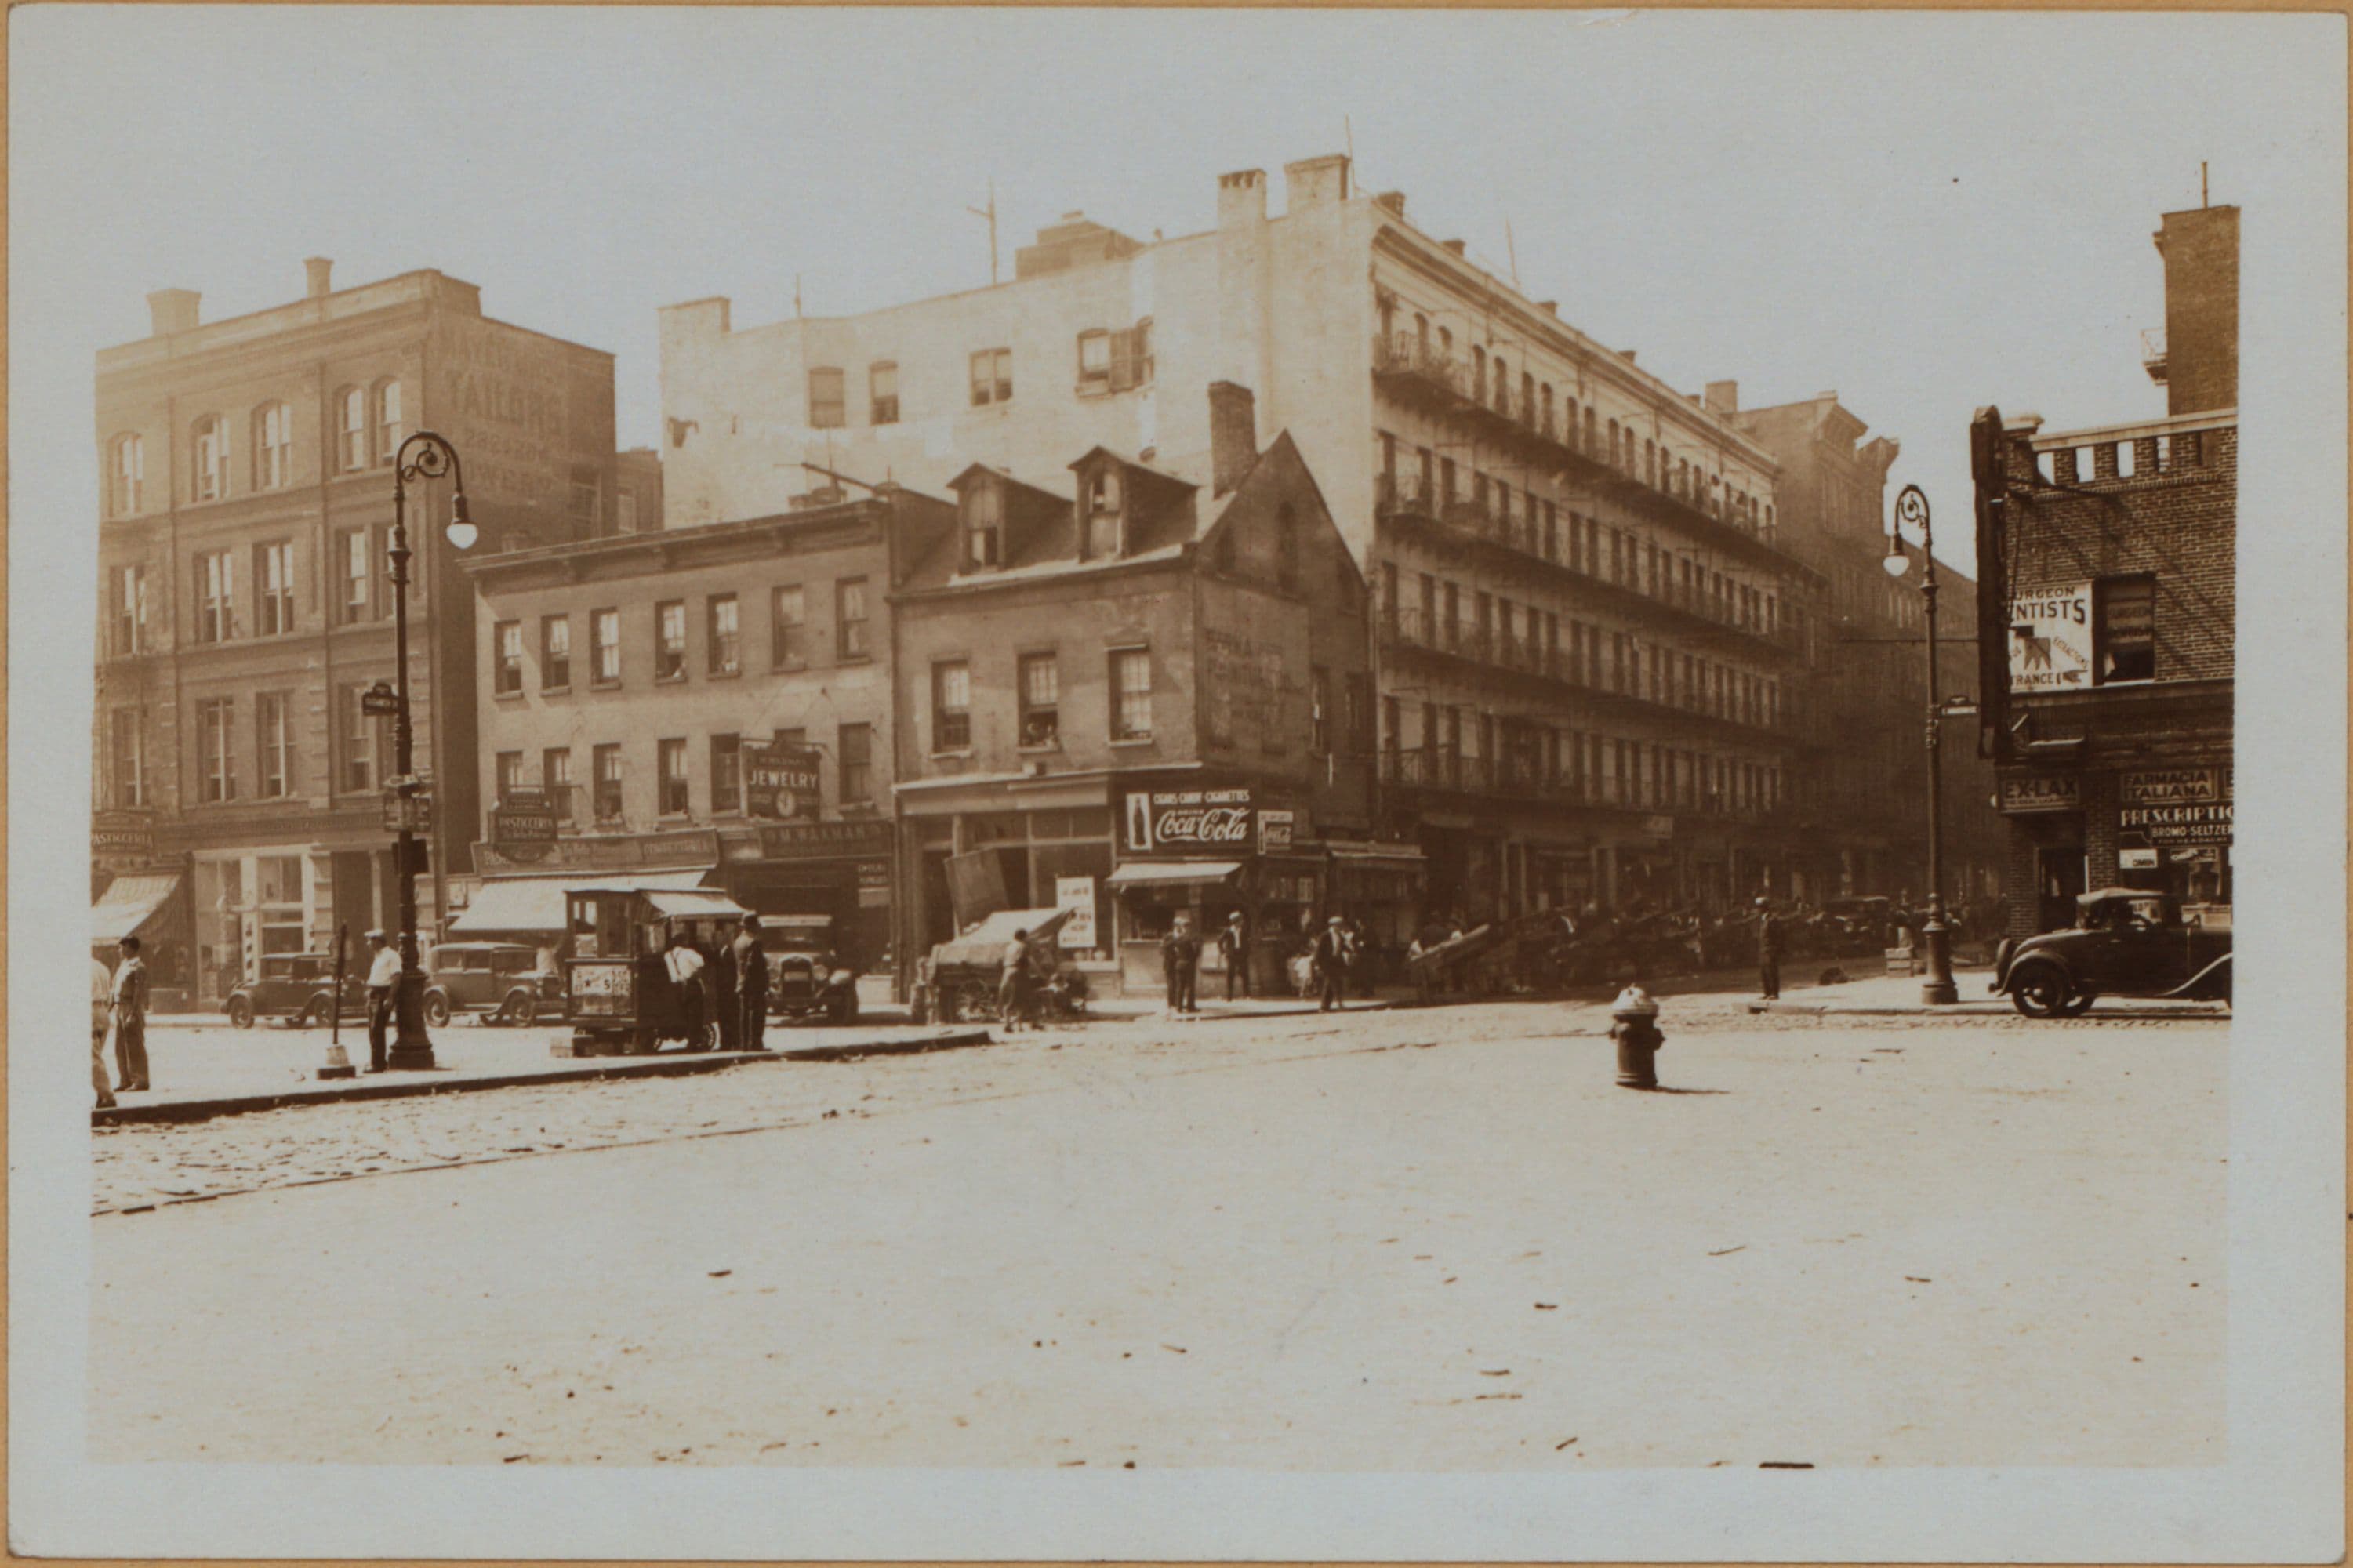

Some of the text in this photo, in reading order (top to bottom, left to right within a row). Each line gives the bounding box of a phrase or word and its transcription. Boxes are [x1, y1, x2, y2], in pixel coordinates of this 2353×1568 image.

[2015, 587, 2075, 601] URGEON
[749, 769, 818, 789] JEWELRY
[2124, 771, 2209, 789] FARMACIA
[2124, 784, 2210, 801] ITALIANA
[1155, 807, 1251, 843] Coca-Cola
[92, 833, 154, 849] ASTICCERIA
